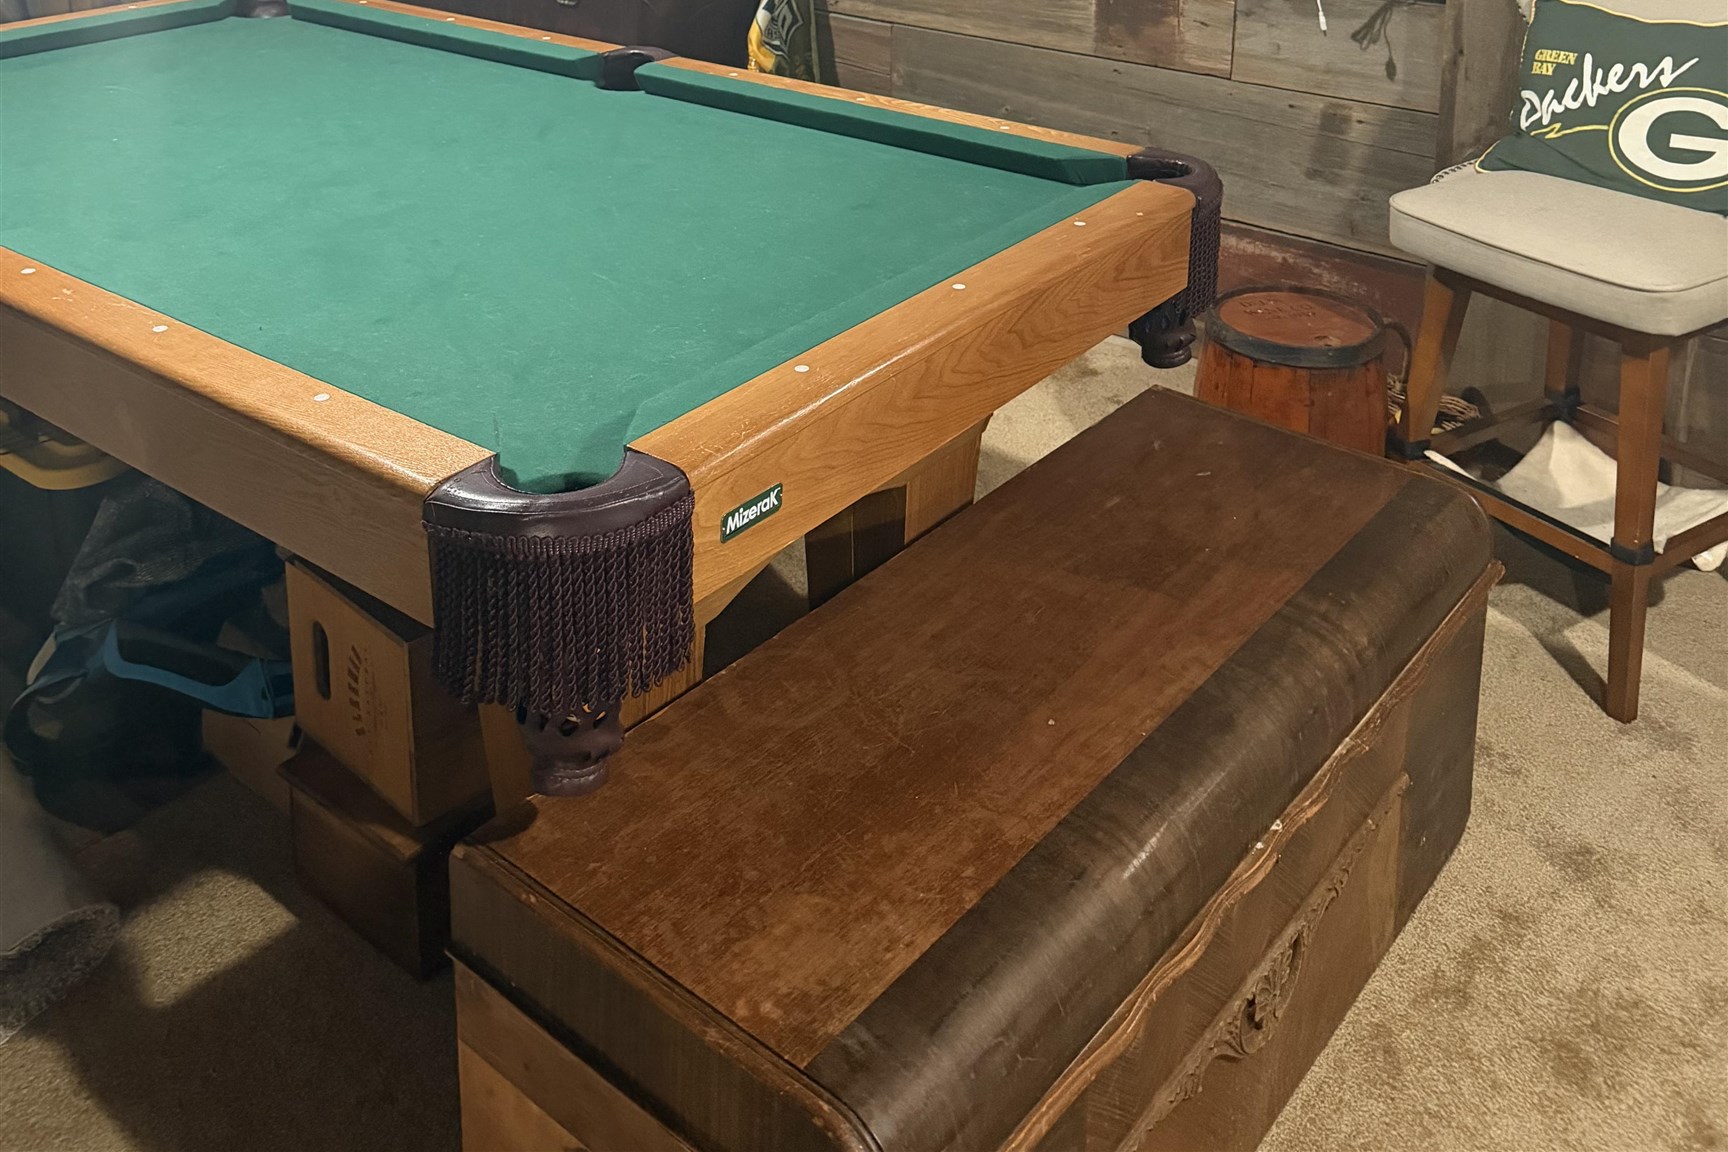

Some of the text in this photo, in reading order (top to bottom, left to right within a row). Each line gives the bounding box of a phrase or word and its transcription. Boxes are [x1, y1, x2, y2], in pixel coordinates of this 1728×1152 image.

[1531, 61, 1557, 76] BAY
[1535, 48, 1578, 66] GREEN
[1519, 52, 1700, 132] Packers
[1618, 96, 1728, 182] G
